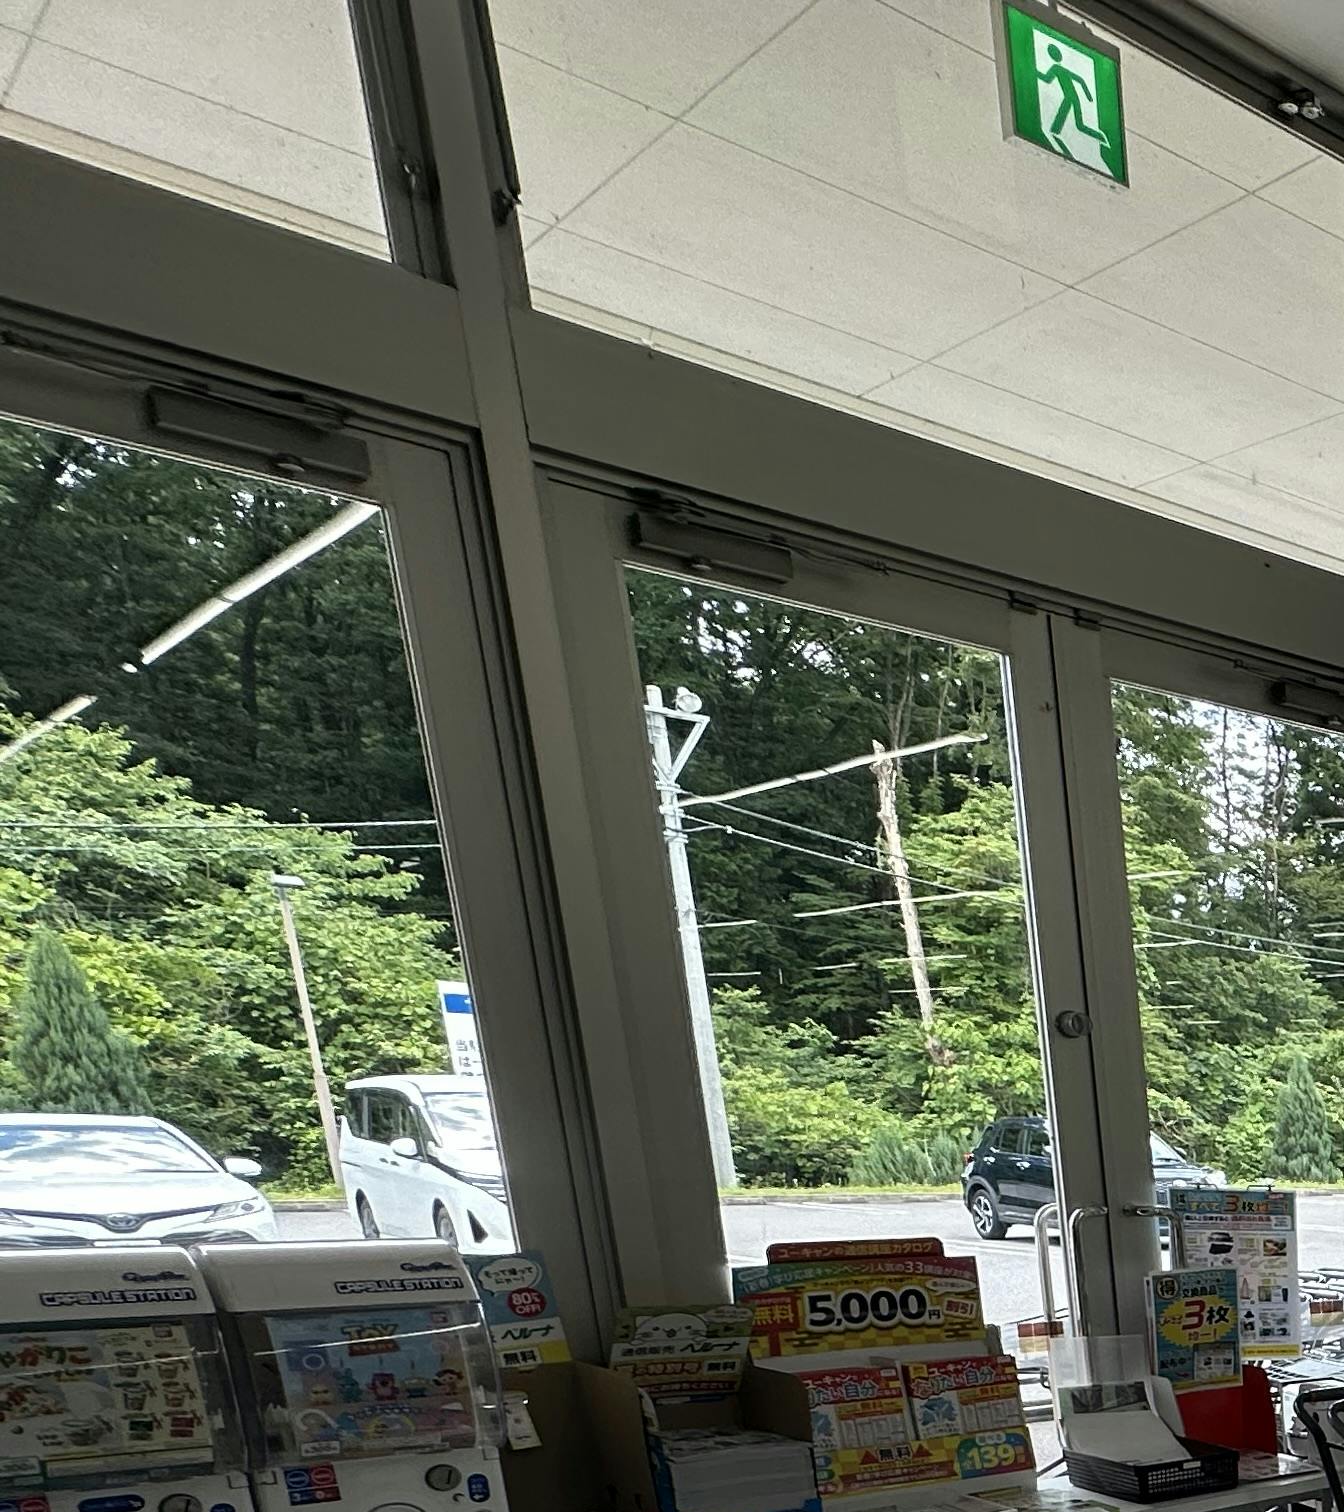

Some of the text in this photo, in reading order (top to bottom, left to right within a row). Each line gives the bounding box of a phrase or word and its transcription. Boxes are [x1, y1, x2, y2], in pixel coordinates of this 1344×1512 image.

[404, 1276, 465, 1292] STATION
[501, 1324, 554, 1341] ベルーナ
[503, 1350, 537, 1366] 無料
